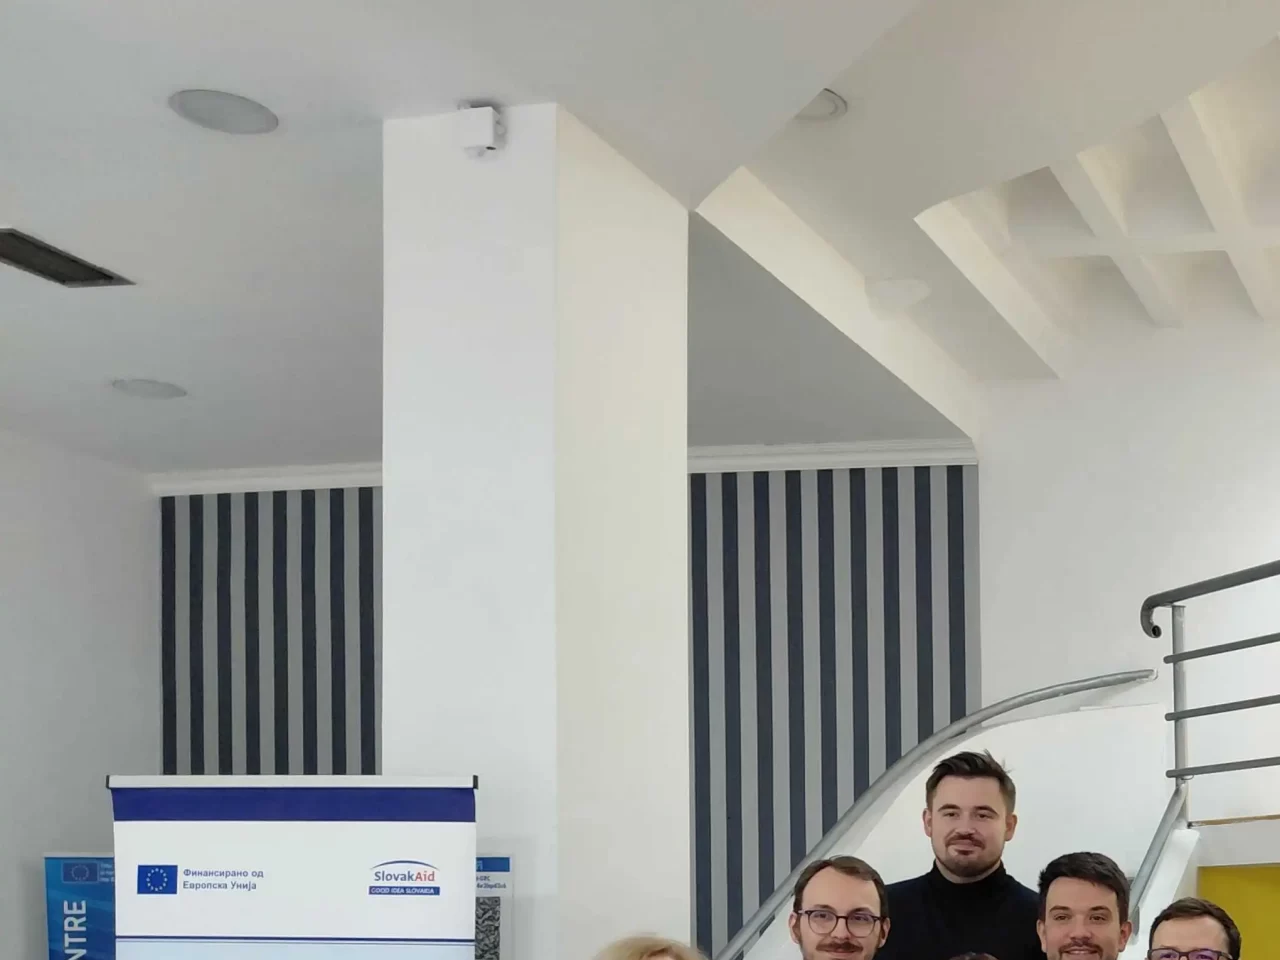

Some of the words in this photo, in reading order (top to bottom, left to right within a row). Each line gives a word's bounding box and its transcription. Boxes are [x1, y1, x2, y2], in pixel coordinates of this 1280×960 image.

[183, 868, 249, 879] Финансирано
[251, 869, 264, 878] од
[374, 870, 435, 882] SlovakAid
[182, 880, 228, 891] Европска
[230, 880, 257, 892] Унија
